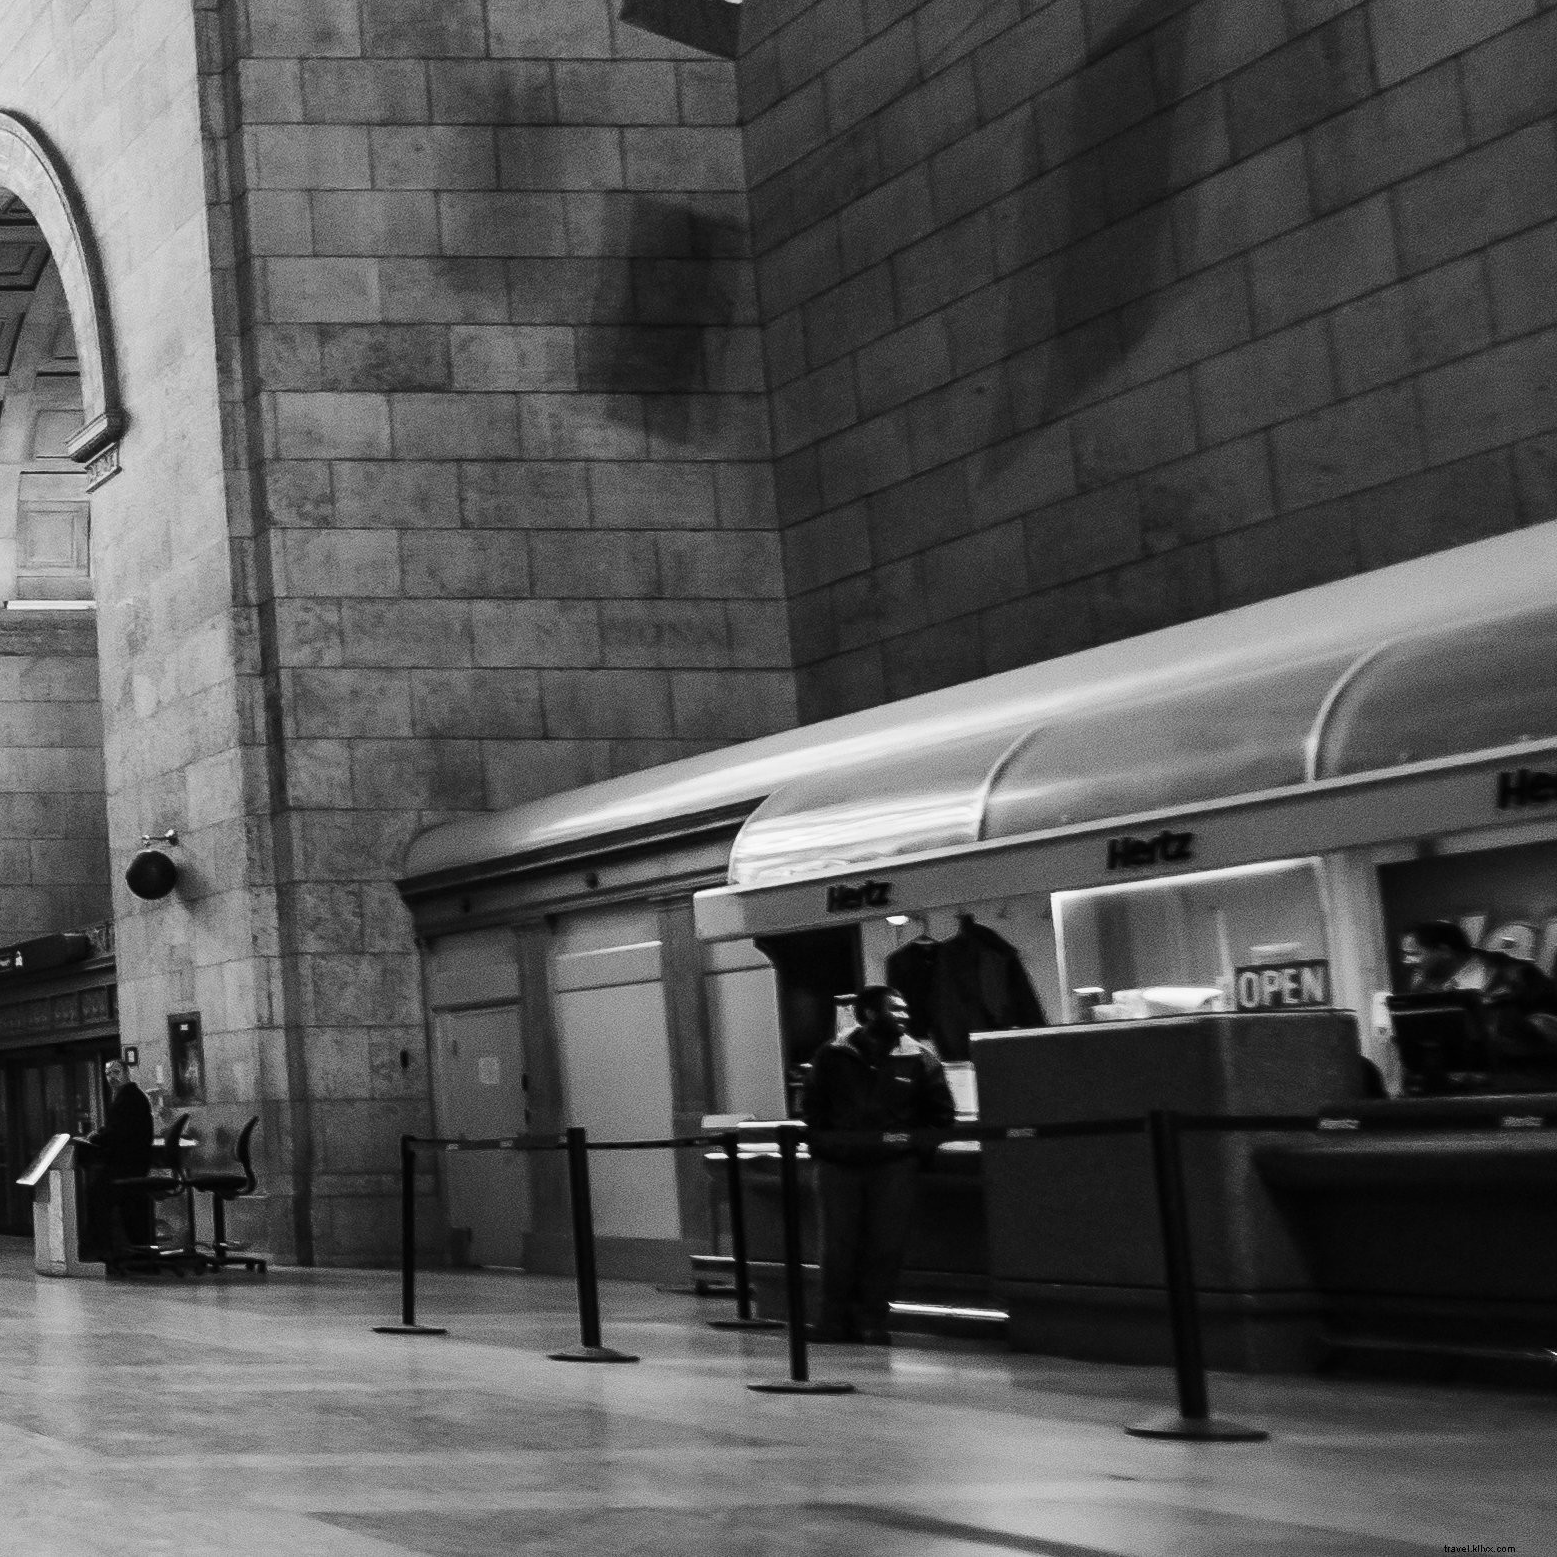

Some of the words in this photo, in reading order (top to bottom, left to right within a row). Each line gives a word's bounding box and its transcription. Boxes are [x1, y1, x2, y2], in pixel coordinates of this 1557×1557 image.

[1107, 830, 1194, 871] Hertz
[826, 880, 892, 913] Hertz
[1239, 968, 1323, 1008] OPEN
